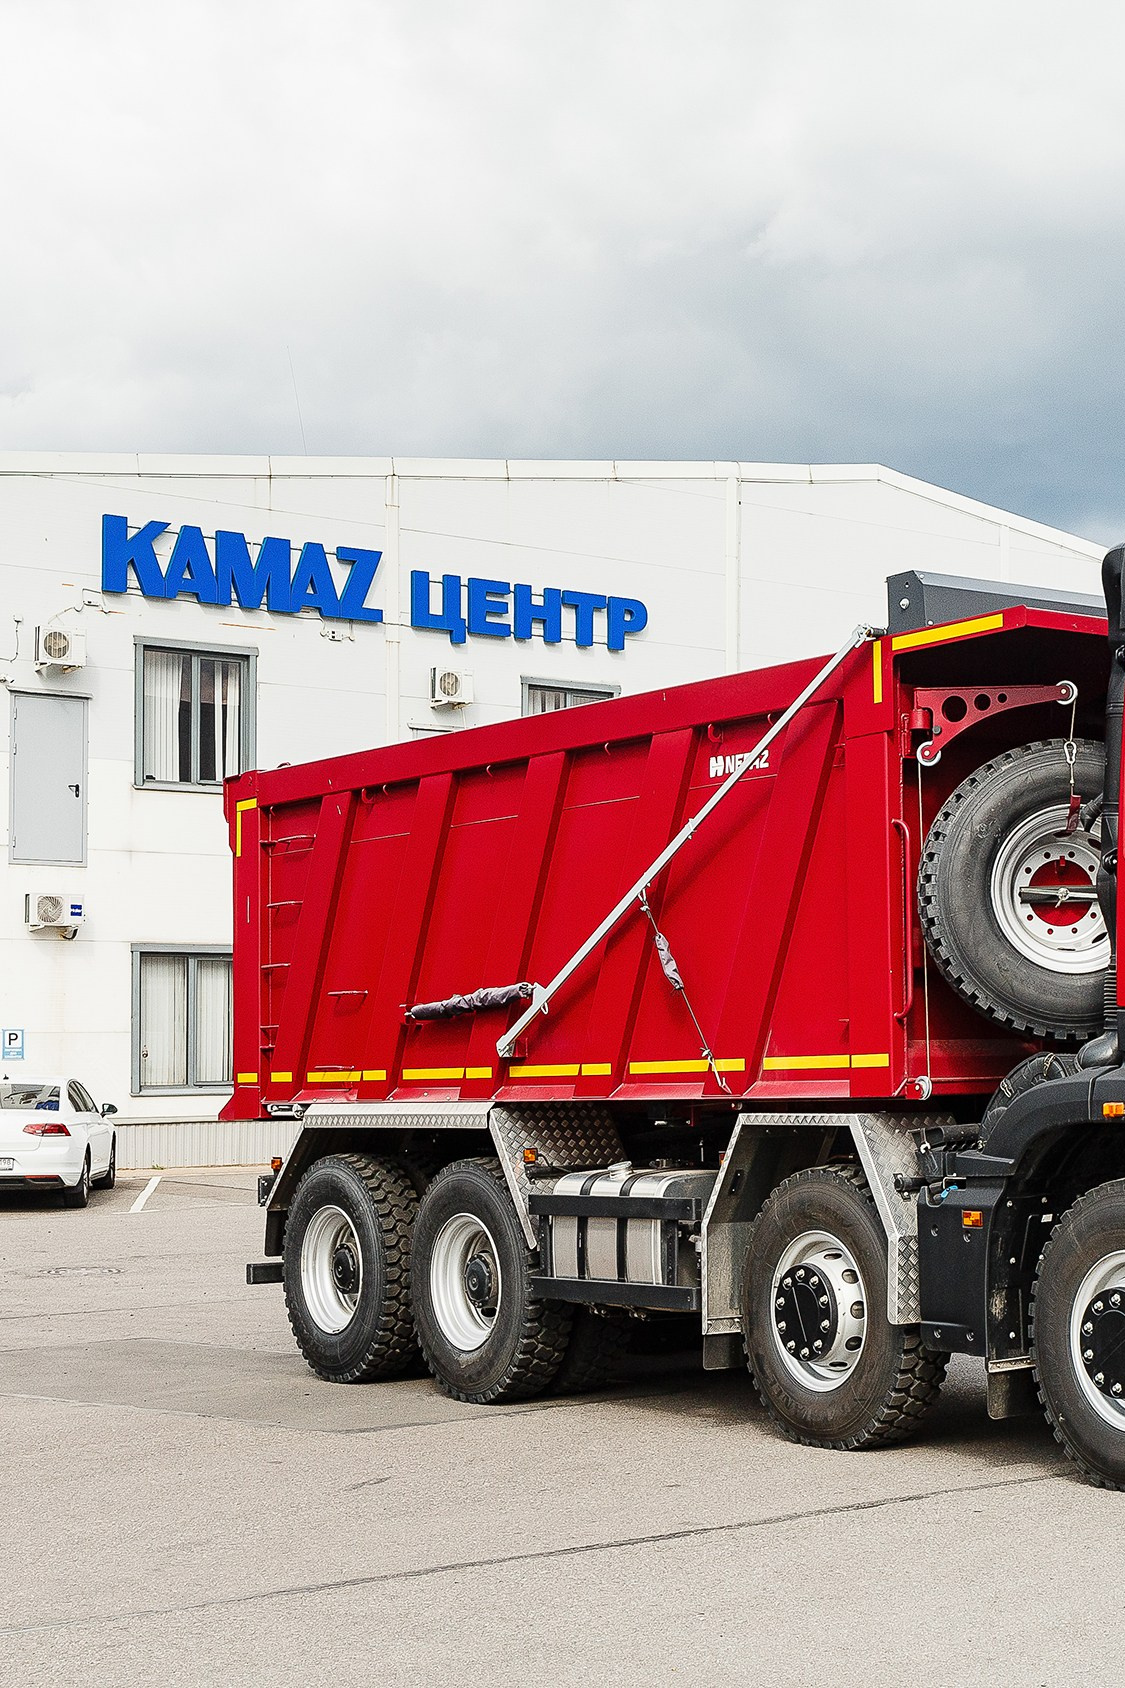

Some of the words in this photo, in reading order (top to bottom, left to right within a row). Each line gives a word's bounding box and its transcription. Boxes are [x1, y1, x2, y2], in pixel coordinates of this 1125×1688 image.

[102, 514, 383, 622] KAMAZ
[411, 570, 648, 651] ЦЕНТР
[8, 1032, 19, 1046] P
